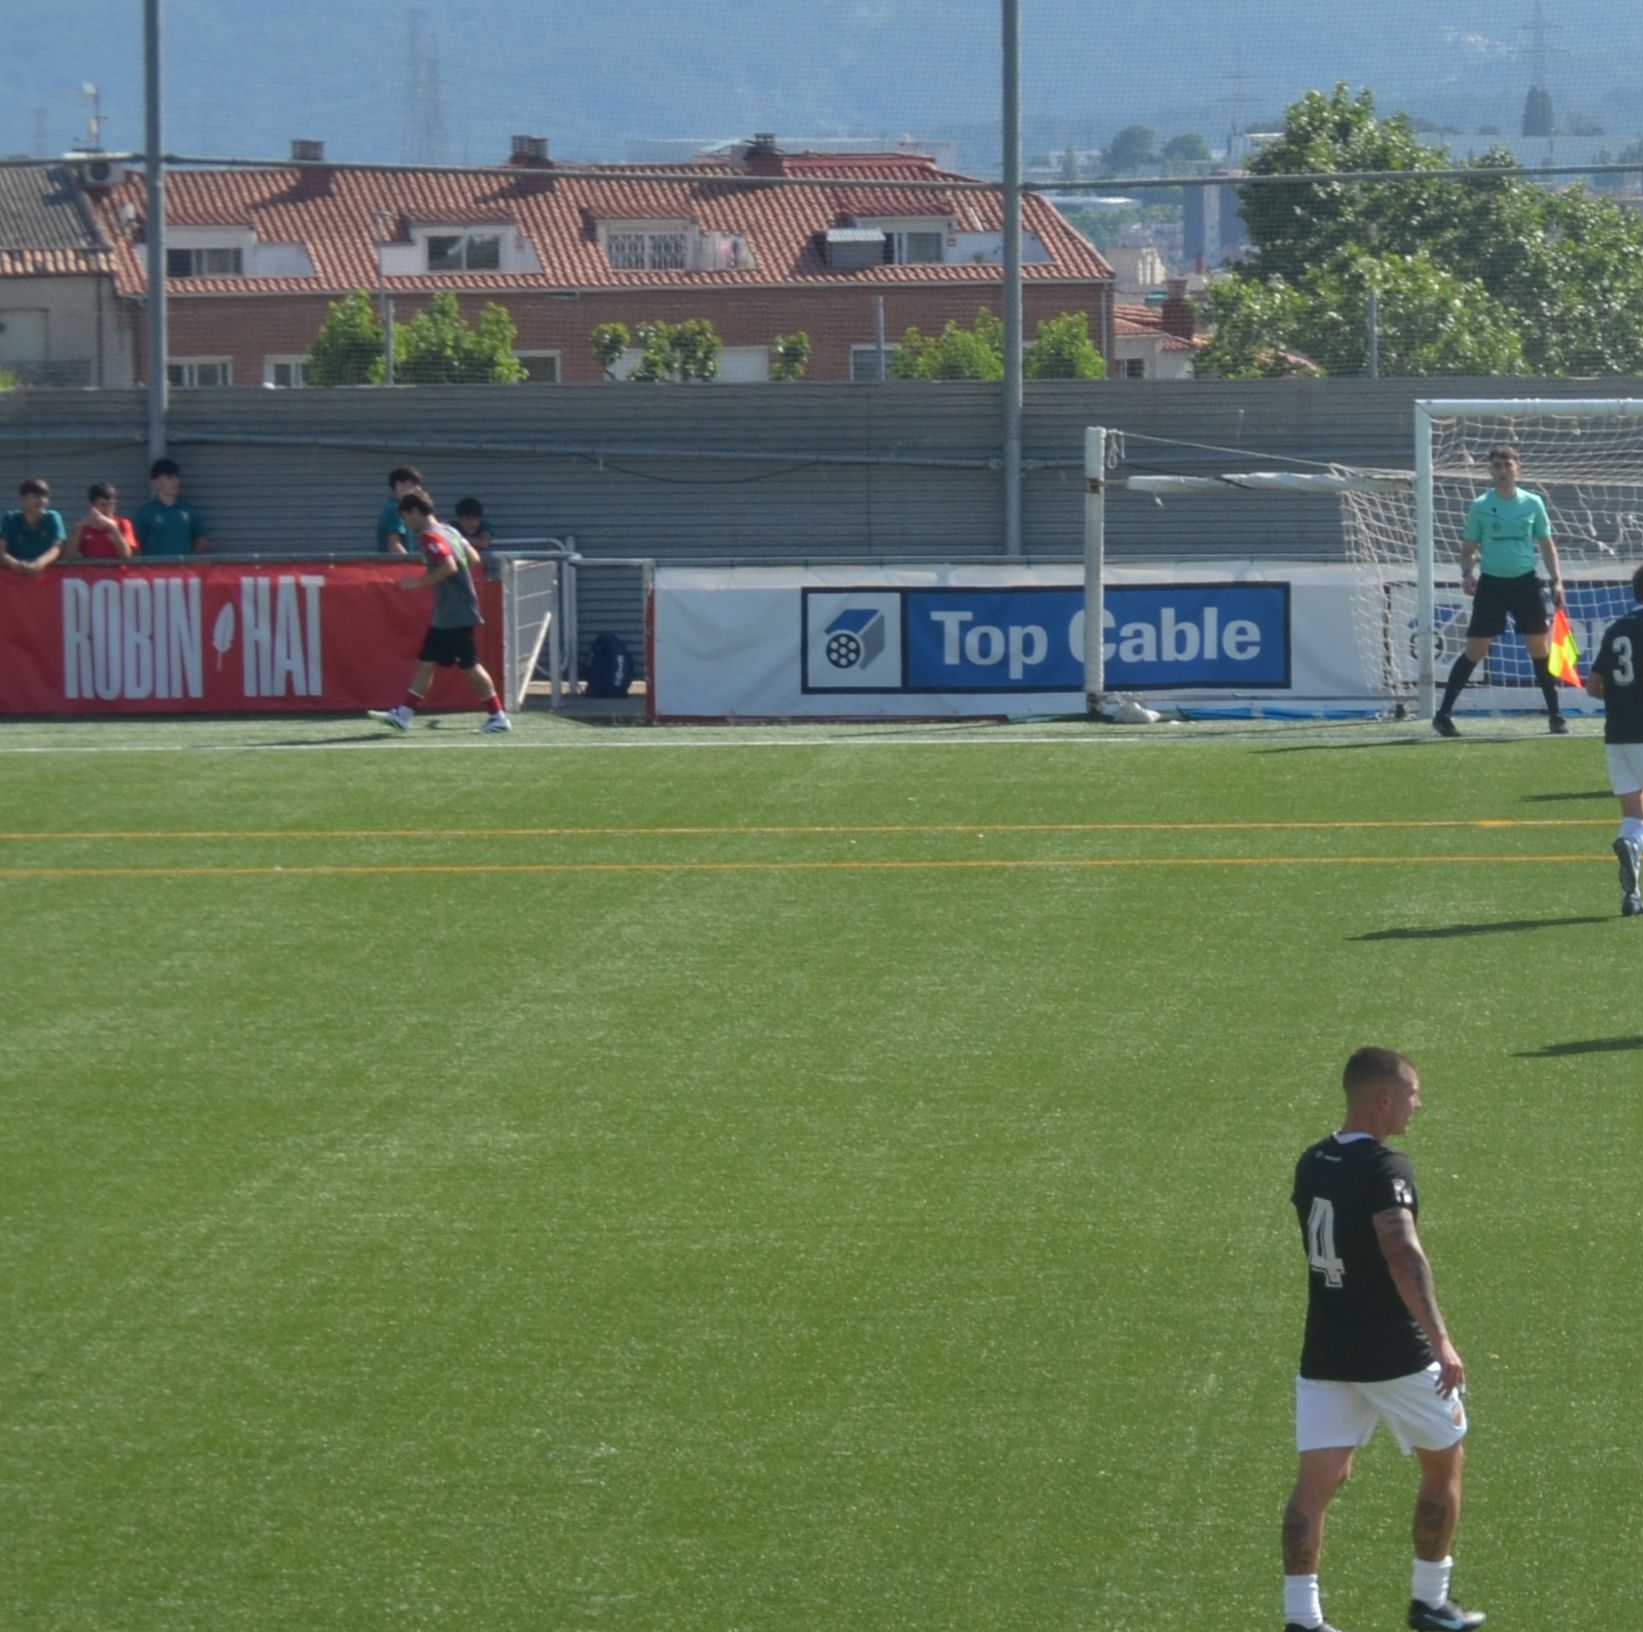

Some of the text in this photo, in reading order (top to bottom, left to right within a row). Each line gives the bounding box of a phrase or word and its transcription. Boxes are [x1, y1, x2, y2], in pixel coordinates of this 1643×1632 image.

[62, 575, 325, 700] ROBIN HAT
[930, 607, 1262, 680] Top Cable
[1612, 635, 1635, 686] 3
[1307, 1196, 1346, 1288] 4
